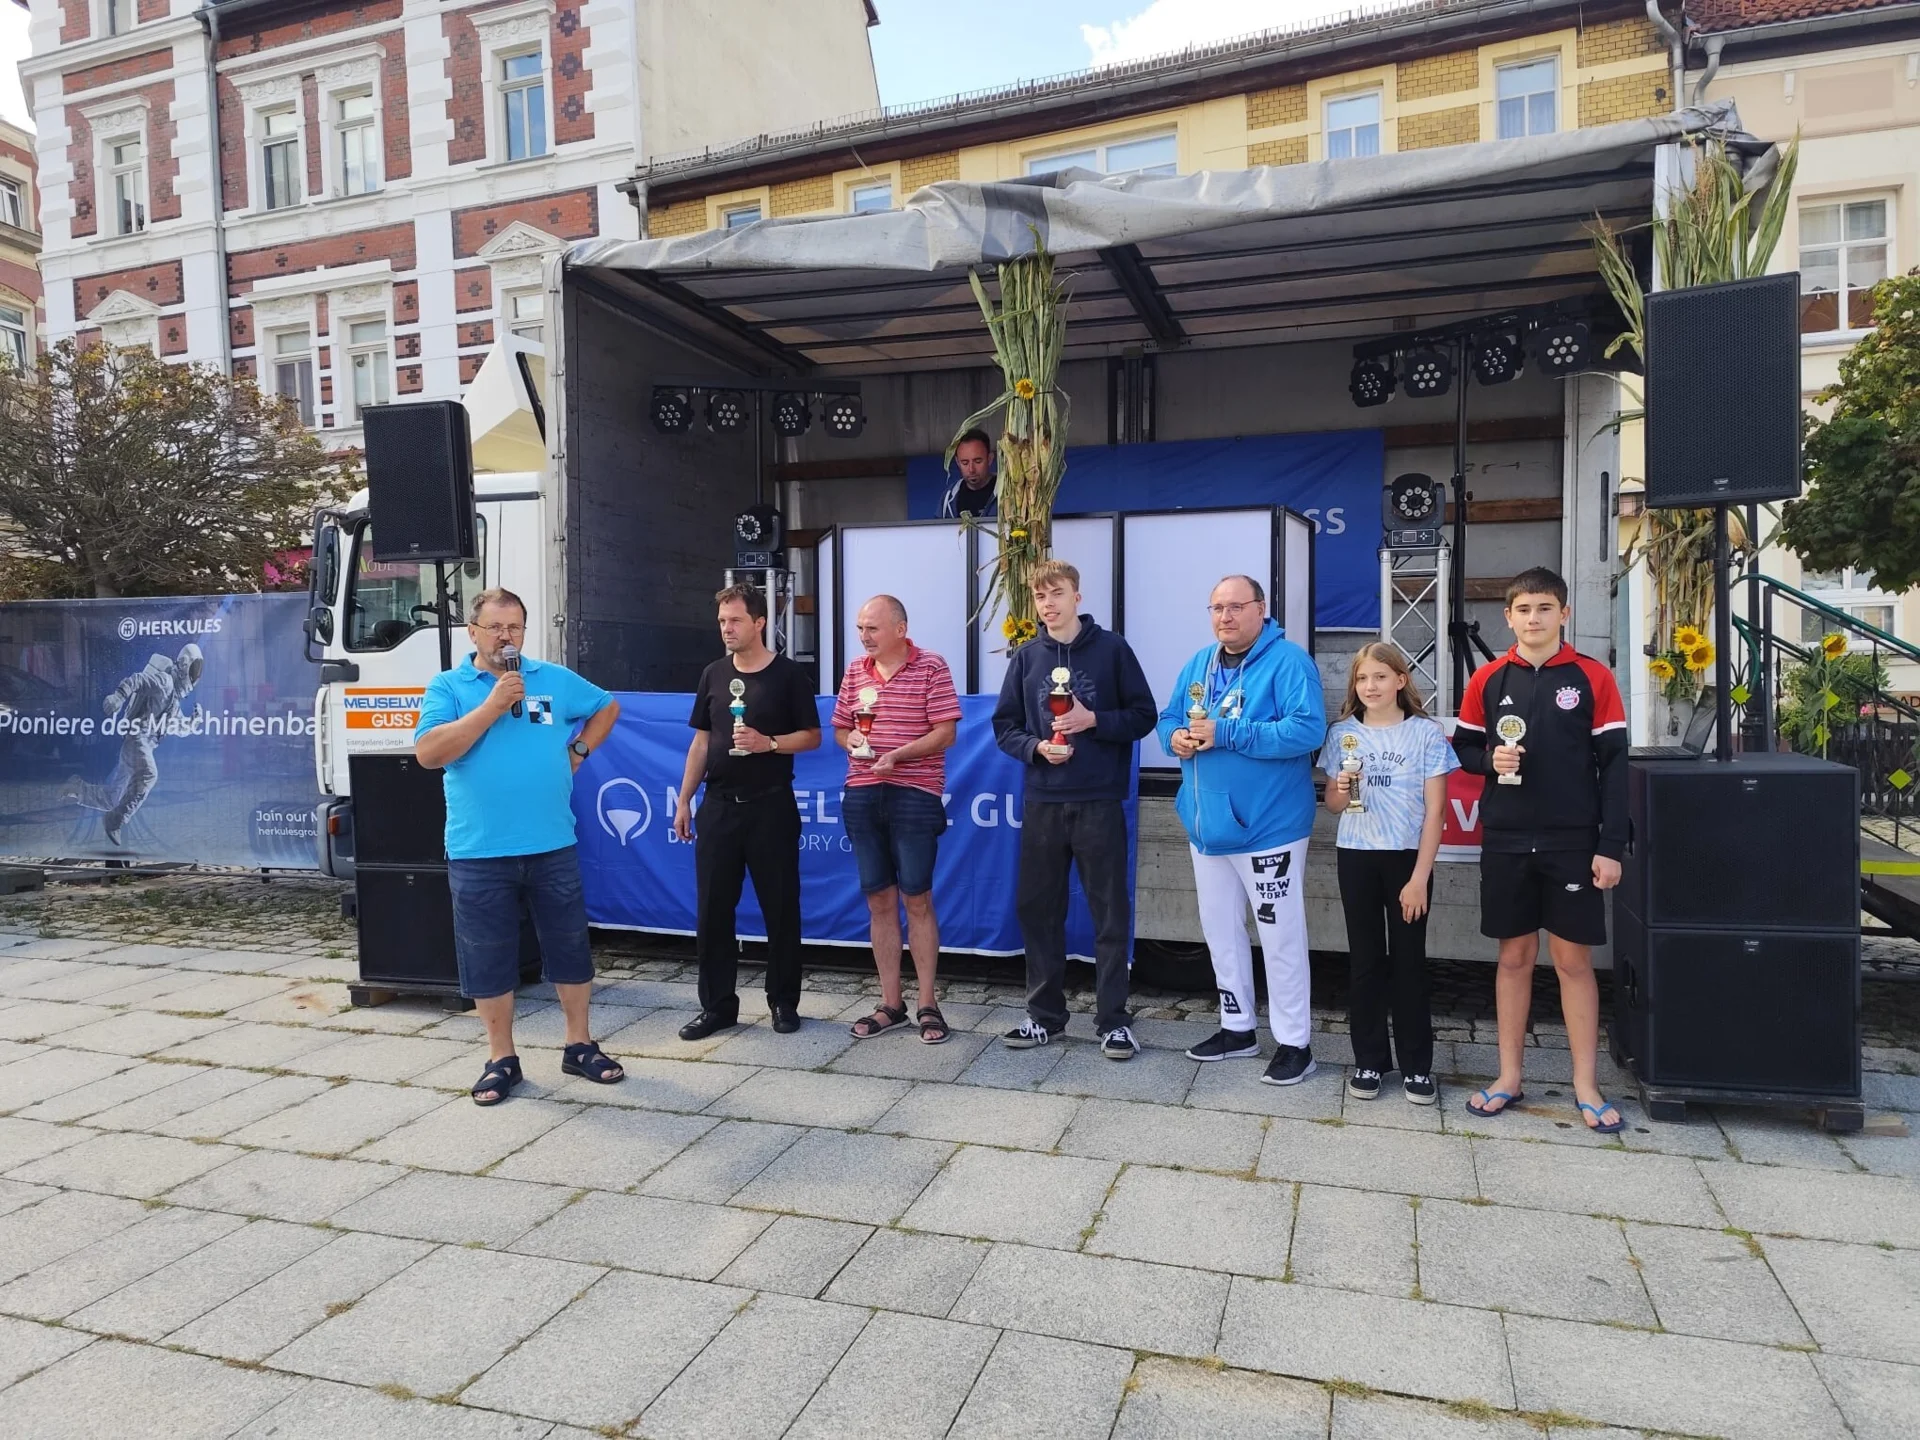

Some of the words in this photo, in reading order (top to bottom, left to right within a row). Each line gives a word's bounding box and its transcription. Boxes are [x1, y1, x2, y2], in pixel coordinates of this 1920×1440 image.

[1303, 507, 1346, 535] SS
[138, 618, 222, 636] HERKULES
[344, 696, 424, 709] MEUSELWI
[0, 709, 95, 735] Pioniere
[101, 711, 141, 736] des
[147, 709, 316, 736] Maschinenba
[371, 713, 414, 728] GUSS
[1381, 751, 1407, 767] COOL
[1367, 775, 1392, 787] KIND
[256, 810, 283, 822] Join
[285, 813, 308, 823] our
[970, 792, 1023, 829] GU
[258, 826, 319, 838] herkulesgrou
[1257, 854, 1285, 866] NEW
[1255, 878, 1291, 892] NEW
[1259, 889, 1288, 900] YORK
